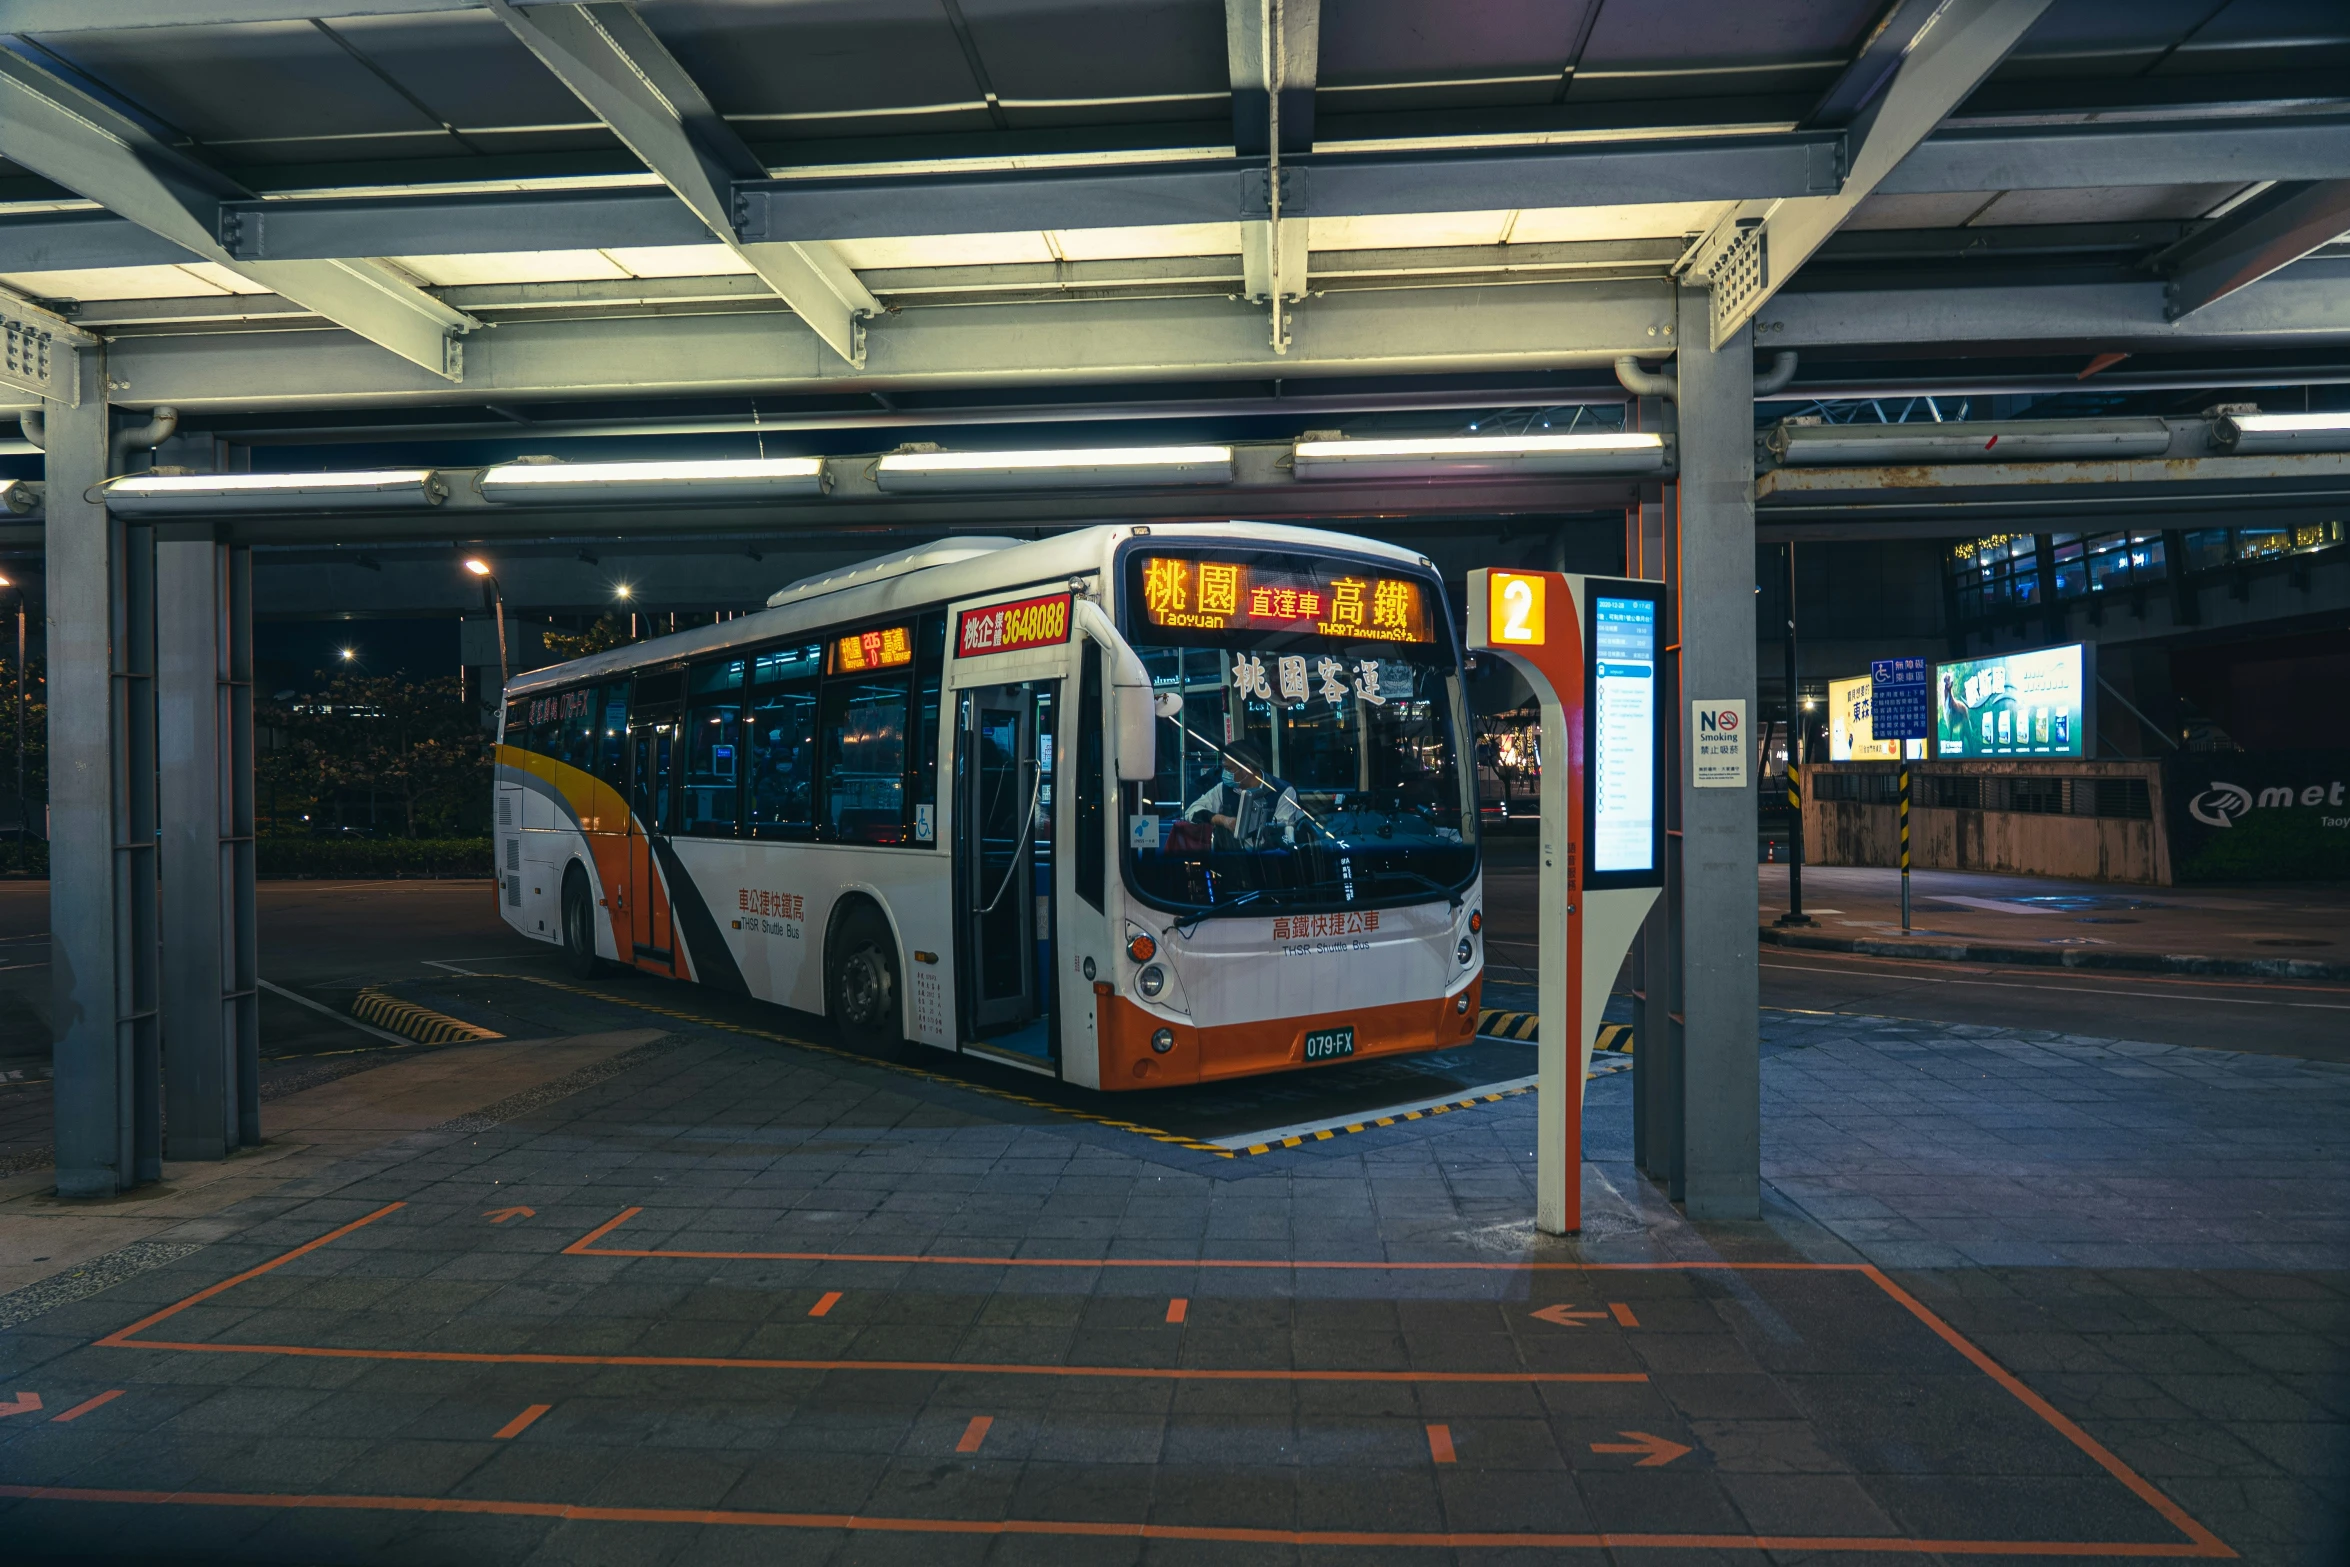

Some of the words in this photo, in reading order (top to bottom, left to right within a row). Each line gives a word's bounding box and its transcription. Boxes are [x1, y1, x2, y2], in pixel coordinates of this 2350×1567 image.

[1145, 558, 1238, 616] 桃園
[1249, 587, 1321, 620] 直達車
[1331, 577, 1409, 628] 高鐵
[1156, 609, 1224, 628] Taoyuan
[1503, 579, 1532, 640] 2
[964, 615, 994, 650] 桃企
[1003, 601, 1065, 645] 3648088
[1895, 659, 1925, 671] 無障礙
[1895, 671, 1925, 682] 乘車區
[1232, 652, 1387, 706] 桃園客運
[1853, 697, 1873, 723] 東森
[1700, 732, 1738, 743] Smoking
[1700, 745, 1739, 755] 禁止吸菸
[741, 916, 759, 932] THSR
[762, 920, 784, 937] Shuttle
[786, 924, 800, 940] Bus
[1273, 910, 1380, 941] 高鐵快捷公車
[1282, 944, 1312, 957] THSR
[1316, 941, 1348, 954] Shuttle
[1352, 940, 1370, 951] Bus
